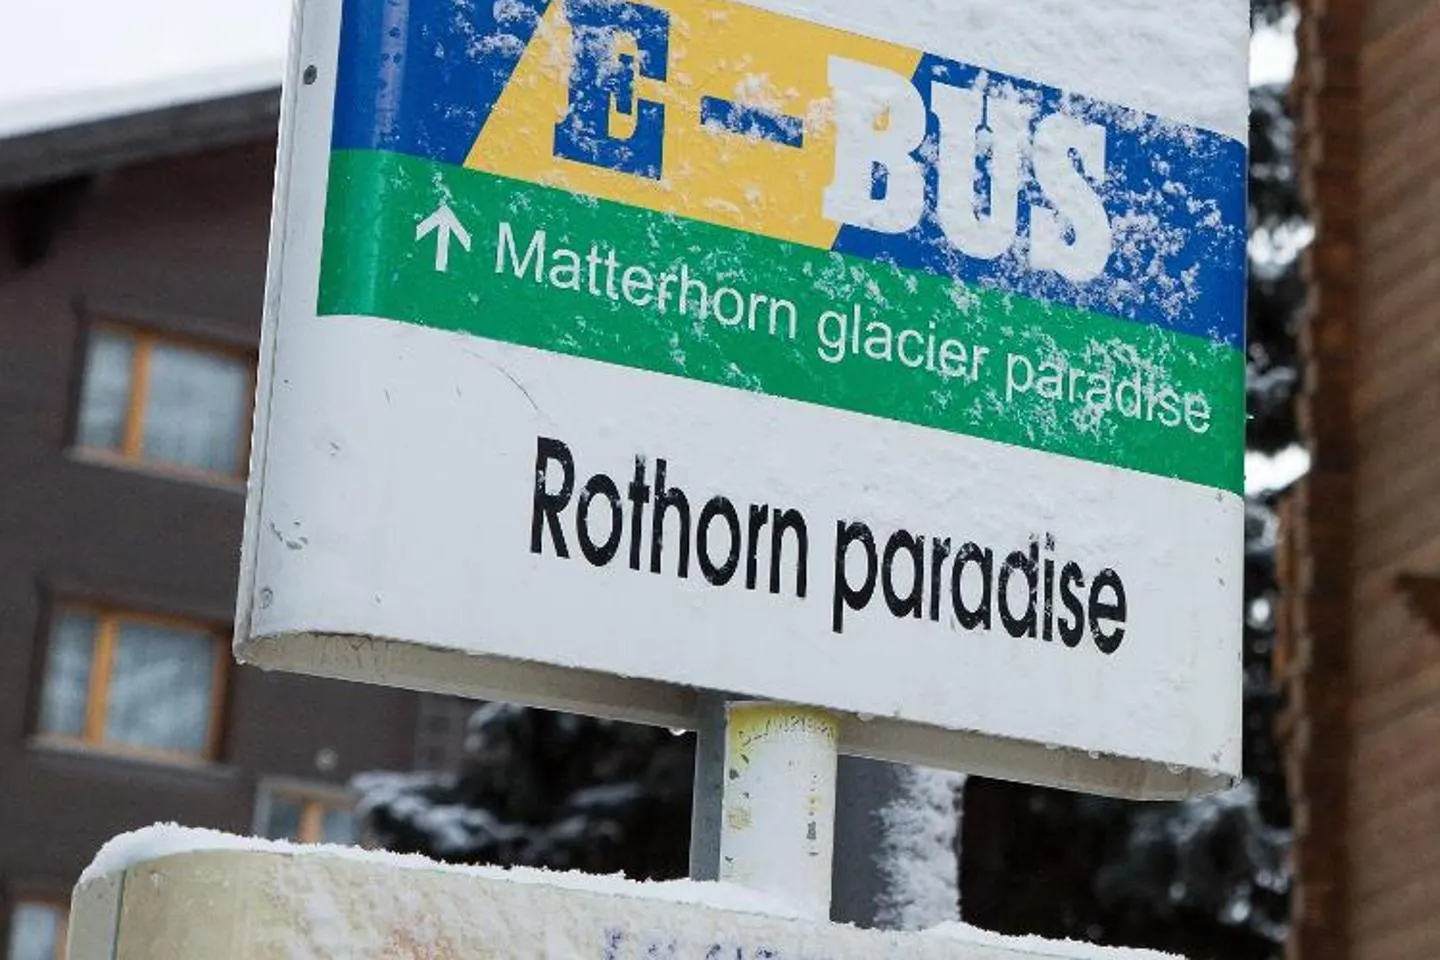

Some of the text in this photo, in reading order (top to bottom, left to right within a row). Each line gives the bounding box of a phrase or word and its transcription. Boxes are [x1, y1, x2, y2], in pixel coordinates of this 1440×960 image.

[494, 221, 1212, 434] Matterhorn glacier paradise
[530, 437, 1128, 655] Rothorn paradise
